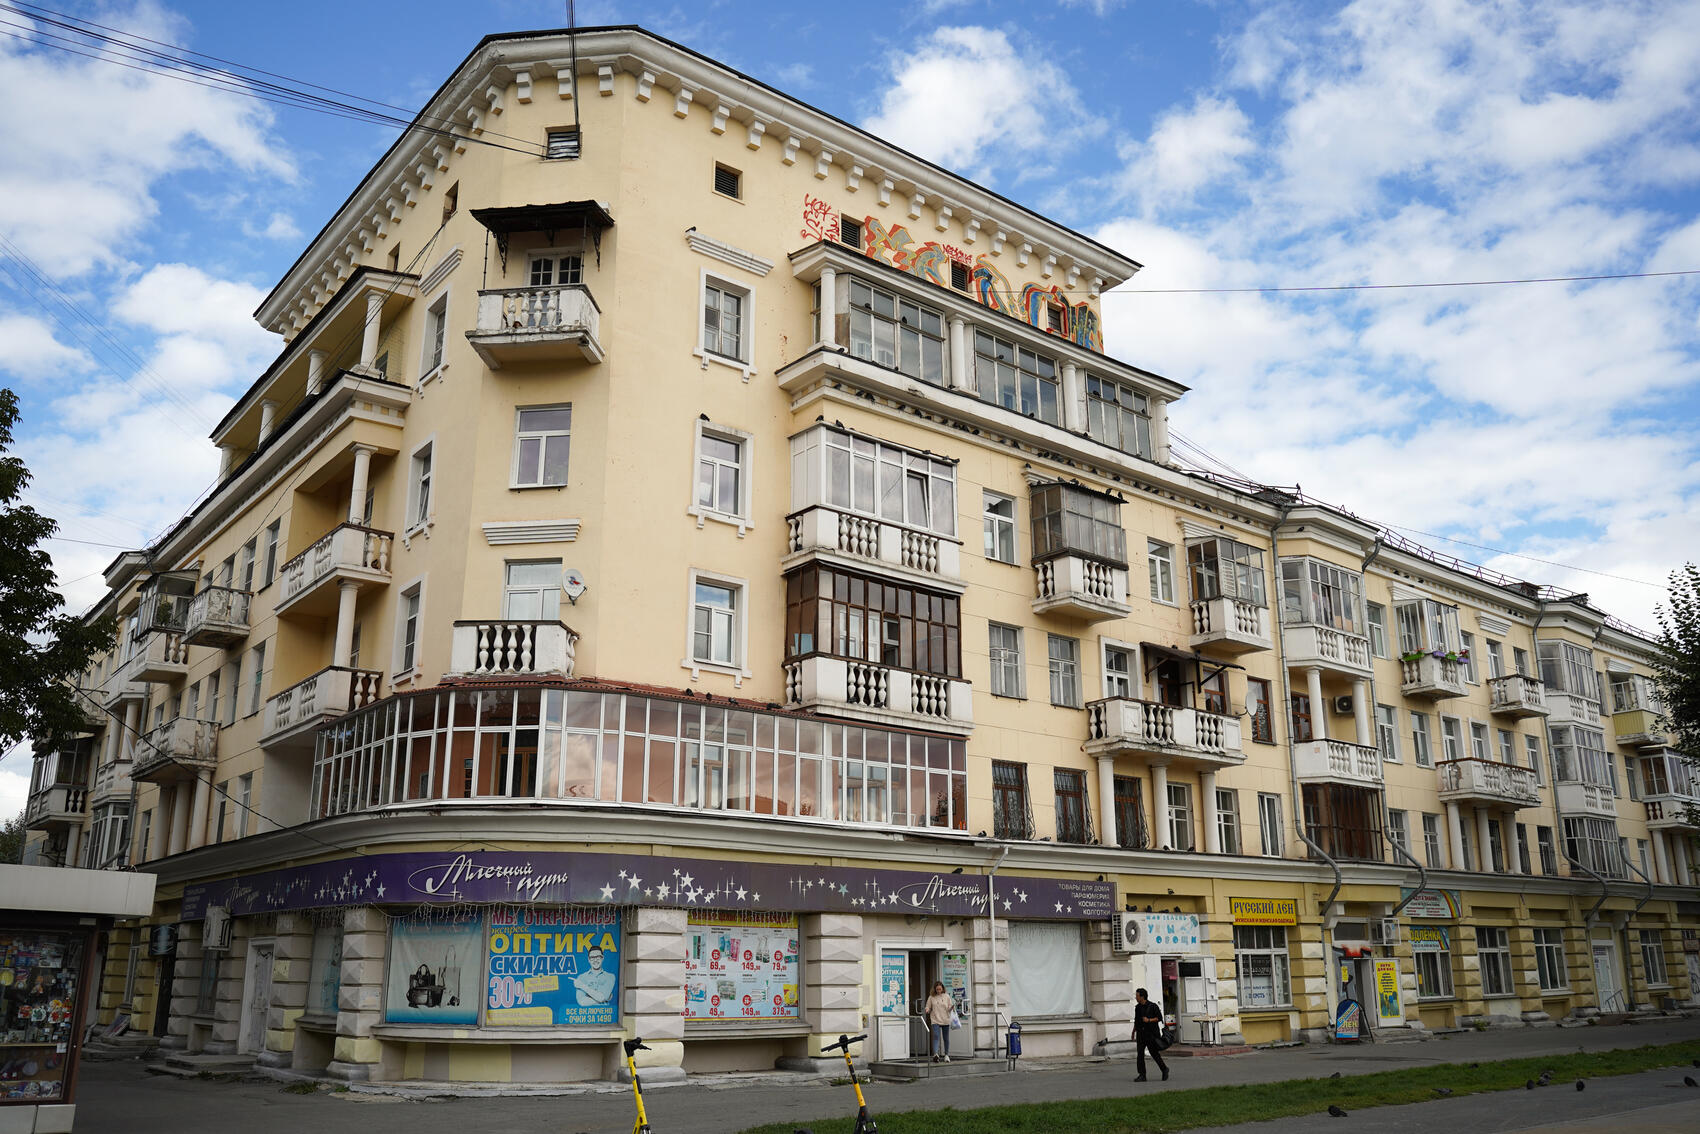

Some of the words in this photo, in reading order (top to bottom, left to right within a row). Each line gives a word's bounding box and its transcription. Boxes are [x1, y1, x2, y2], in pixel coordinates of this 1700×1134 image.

[425, 854, 534, 893] Млечный
[517, 872, 569, 901] путь
[911, 874, 981, 907] Млечный
[1058, 883, 1081, 891] ТОВАРЫ
[492, 909, 518, 925] МЫ
[1234, 901, 1274, 917] РУССКИЙ
[492, 925, 530, 936] экспресс
[490, 933, 617, 954] ОПТИКА
[489, 955, 578, 977] СКИДКА
[489, 976, 533, 1009] 30%
[566, 1007, 577, 1015] ВСЕ
[569, 1015, 586, 1023] ОЧКИ
[587, 1015, 596, 1023] ЗА
